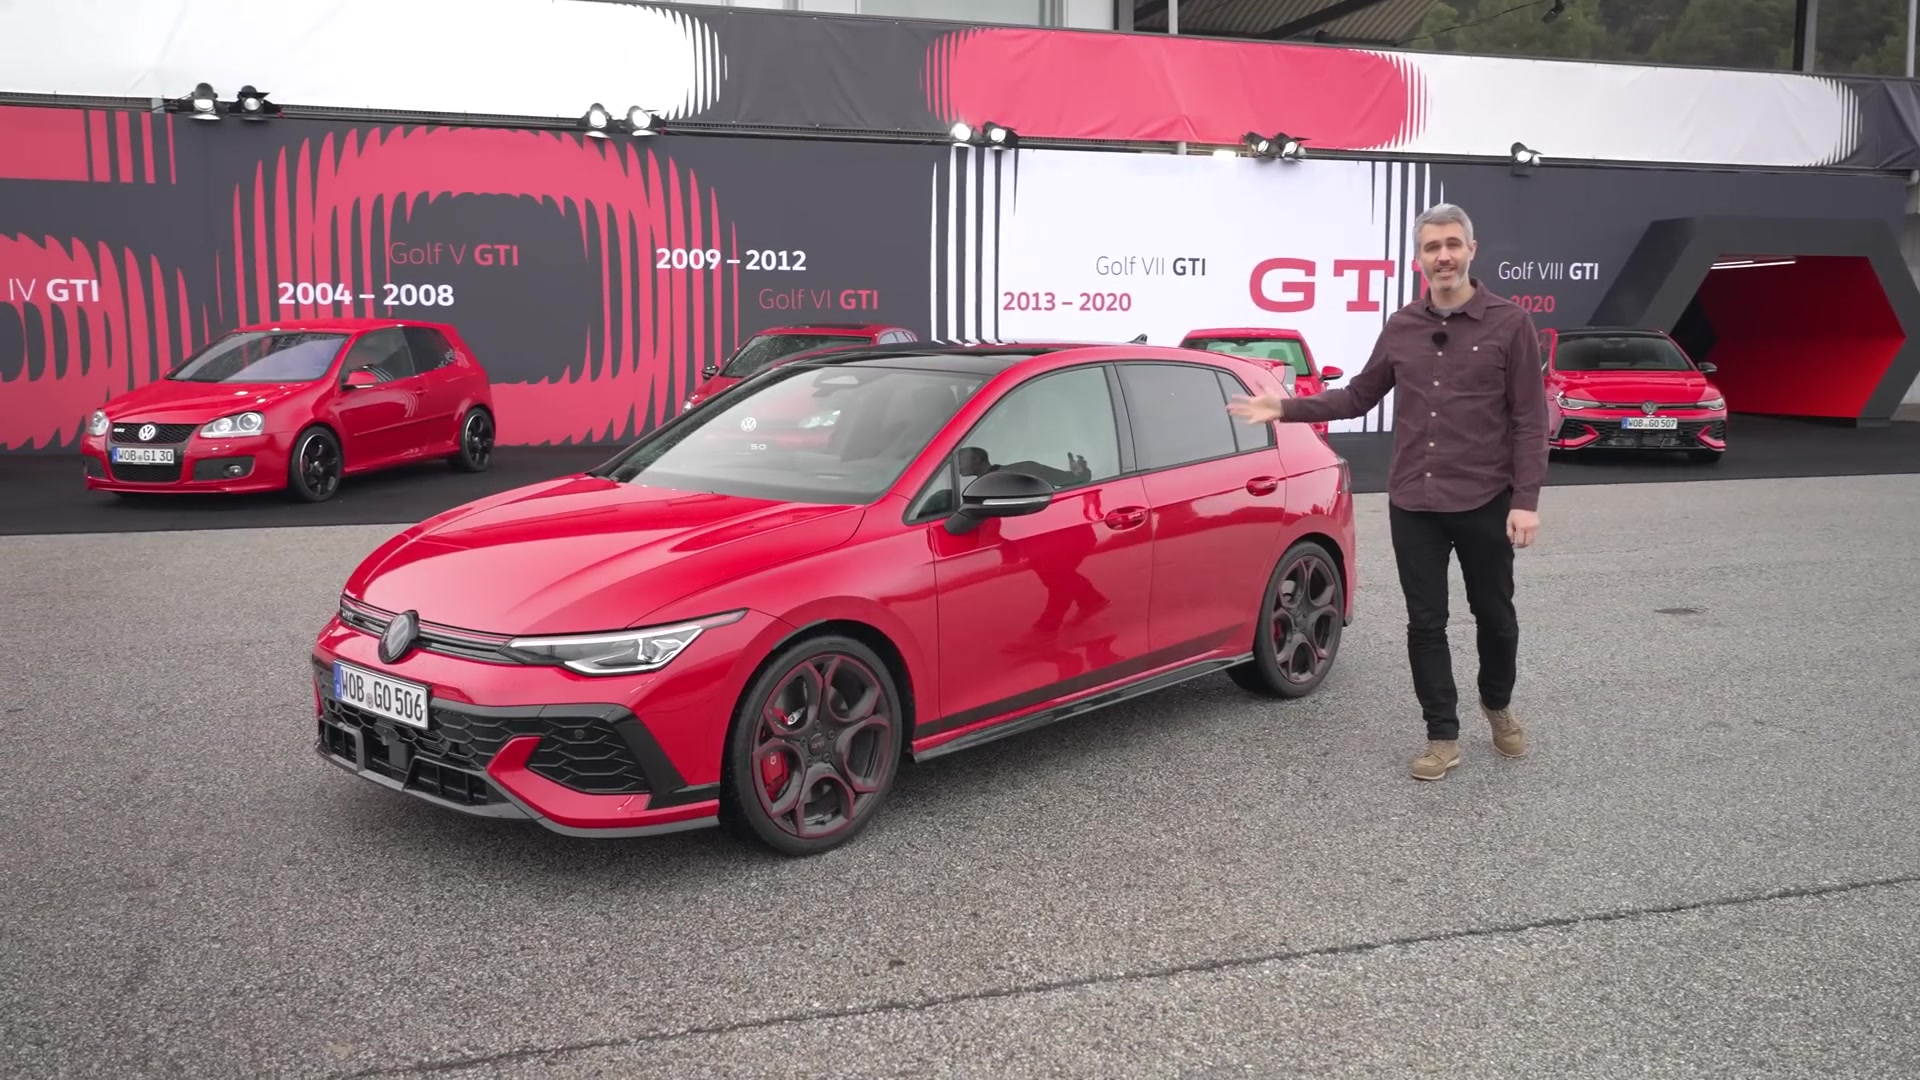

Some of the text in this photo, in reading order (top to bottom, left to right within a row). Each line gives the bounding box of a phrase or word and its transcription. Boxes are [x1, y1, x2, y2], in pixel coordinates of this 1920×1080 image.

[390, 242, 520, 267] Golf V GTI
[655, 248, 722, 270] 2009
[745, 249, 807, 271] 2012
[1096, 256, 1206, 276] Golf VII GTI
[1498, 260, 1599, 280] Golf VIII GTI
[9, 278, 99, 302] IV GTI
[278, 282, 353, 305] 2004
[383, 284, 455, 307] 2008
[758, 288, 880, 310] Golf VI GTI
[1003, 291, 1056, 312] 2013
[1079, 291, 1132, 312] 2020
[1628, 419, 1643, 427] WOB
[1661, 419, 1676, 428] 507
[118, 449, 137, 461] WOB
[159, 450, 173, 462] 30
[341, 668, 424, 721] WOB GO 506
